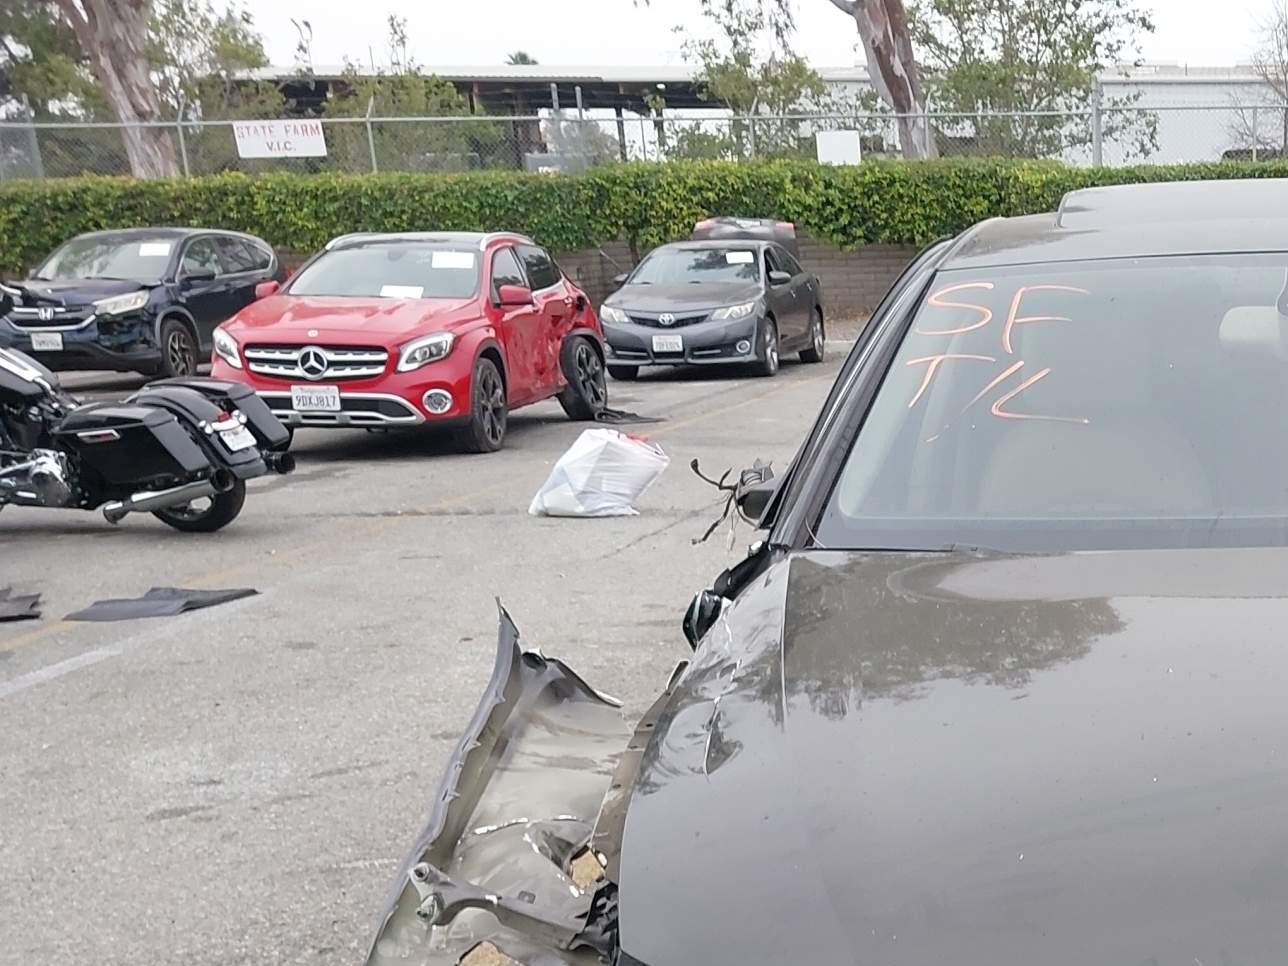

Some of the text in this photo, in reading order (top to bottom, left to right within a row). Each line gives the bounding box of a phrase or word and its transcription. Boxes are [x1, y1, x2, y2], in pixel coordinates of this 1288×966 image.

[236, 123, 321, 138] STATE FARM
[266, 141, 297, 152] V.I.C.
[295, 394, 336, 407] 9DXJ817
